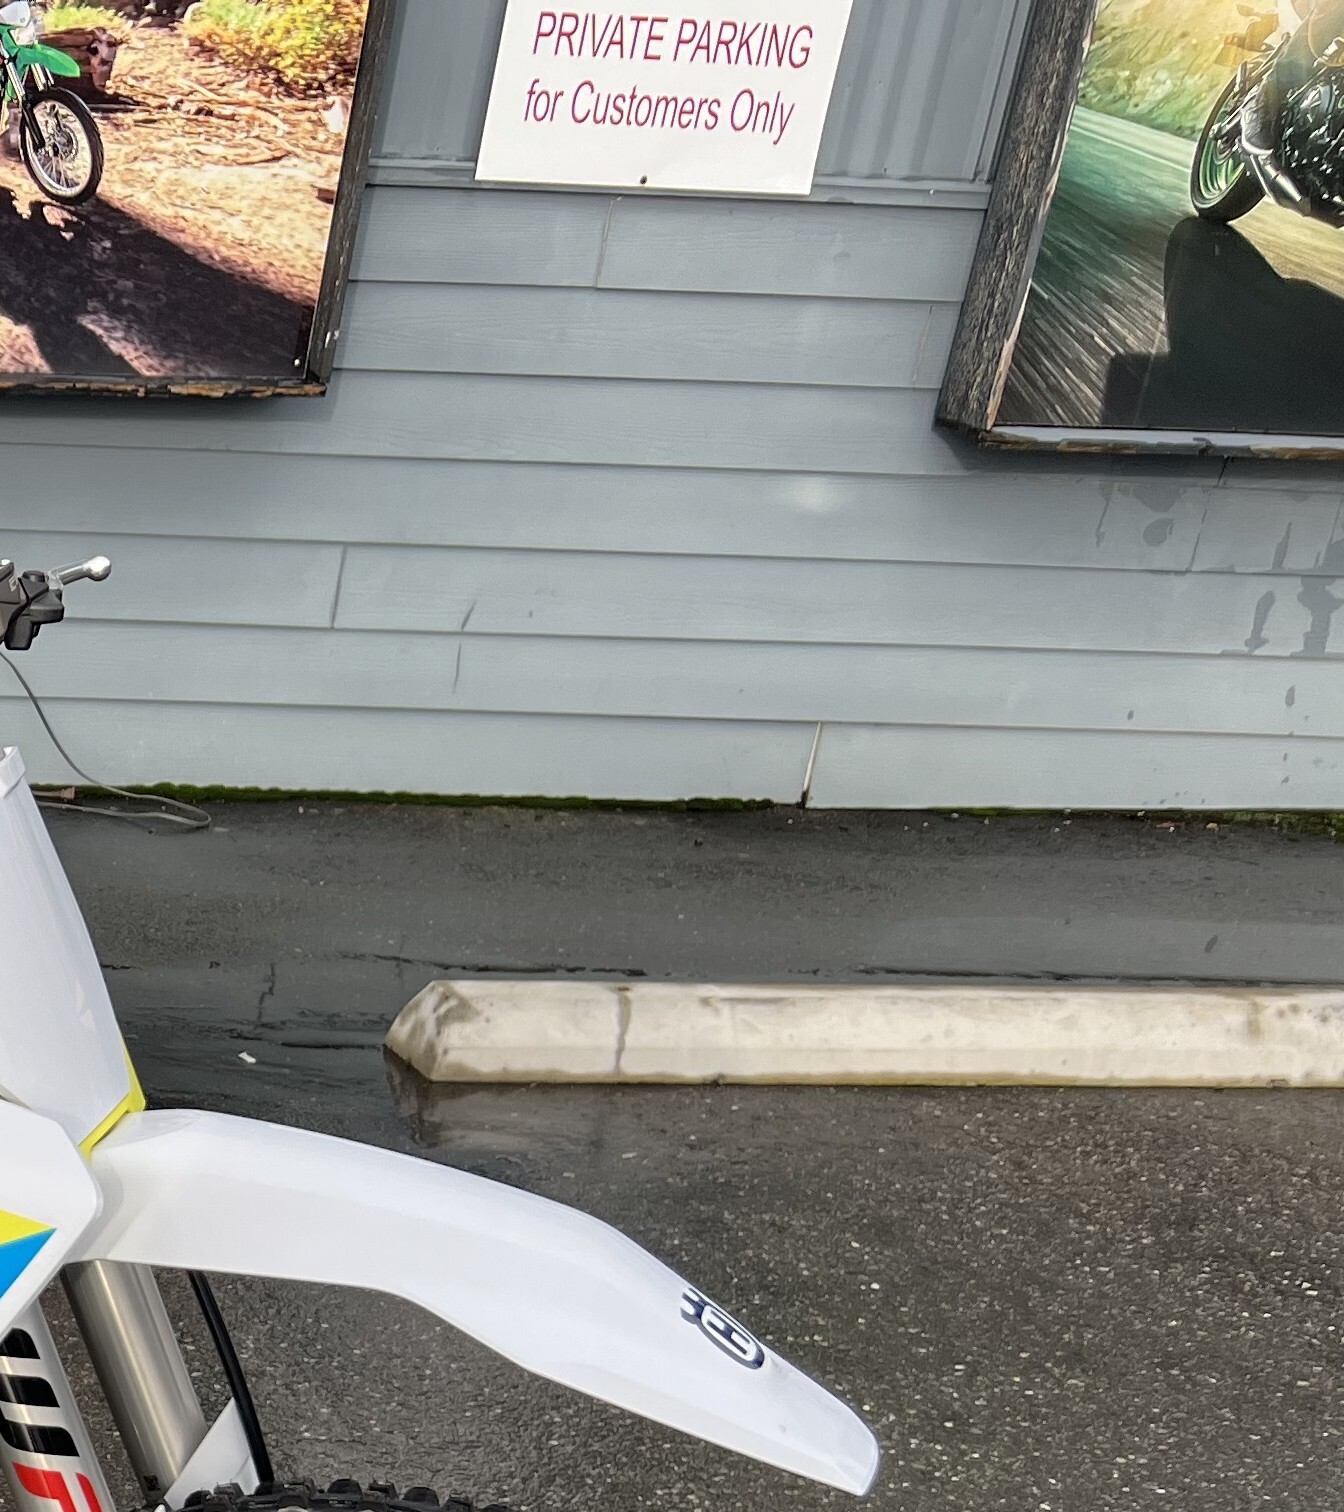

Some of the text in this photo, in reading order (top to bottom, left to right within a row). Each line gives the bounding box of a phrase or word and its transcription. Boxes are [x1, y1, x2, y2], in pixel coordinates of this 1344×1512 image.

[532, 10, 814, 69] PRIVATE PARKING
[523, 77, 796, 146] for Customers Only
